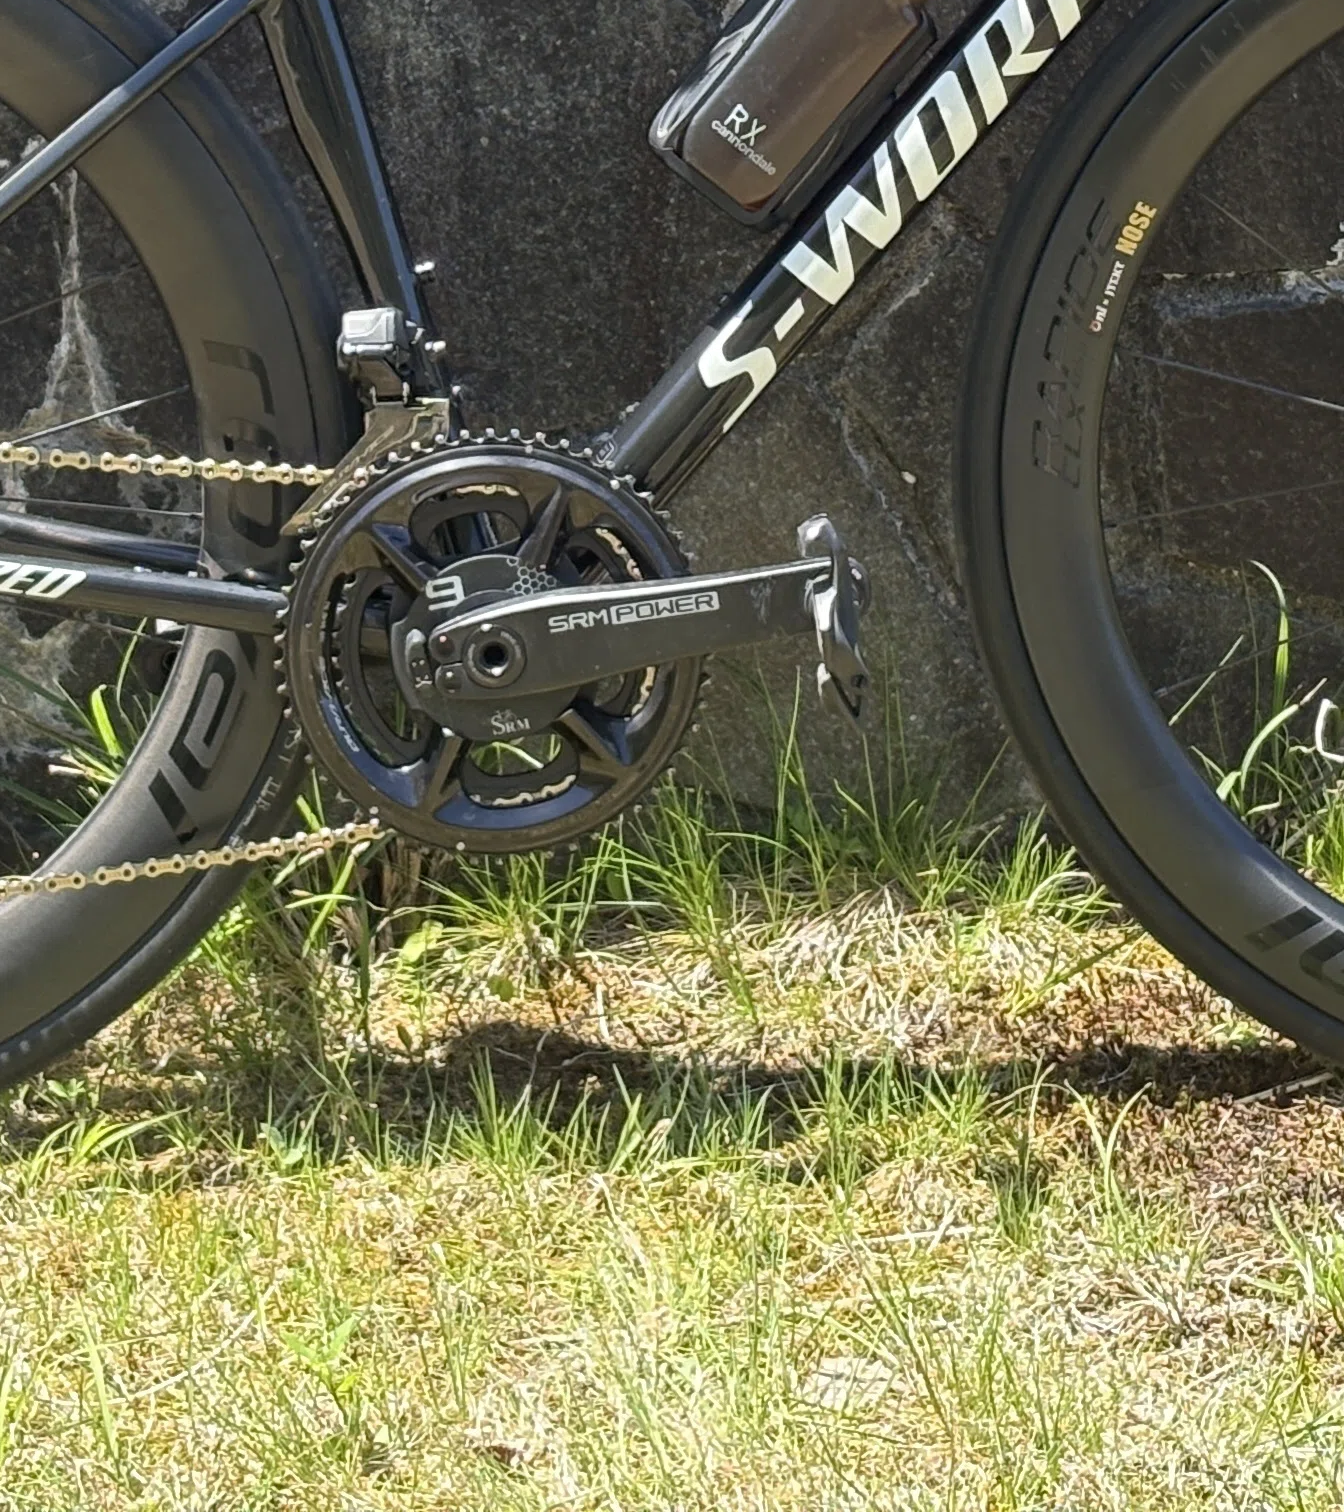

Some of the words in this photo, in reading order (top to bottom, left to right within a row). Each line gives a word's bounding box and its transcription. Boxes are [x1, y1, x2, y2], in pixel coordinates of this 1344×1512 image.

[723, 103, 767, 147] RX
[1115, 200, 1158, 257] NOSE
[548, 607, 609, 634] SRM
[614, 592, 718, 624] POWER
[490, 713, 531, 737] SRM
